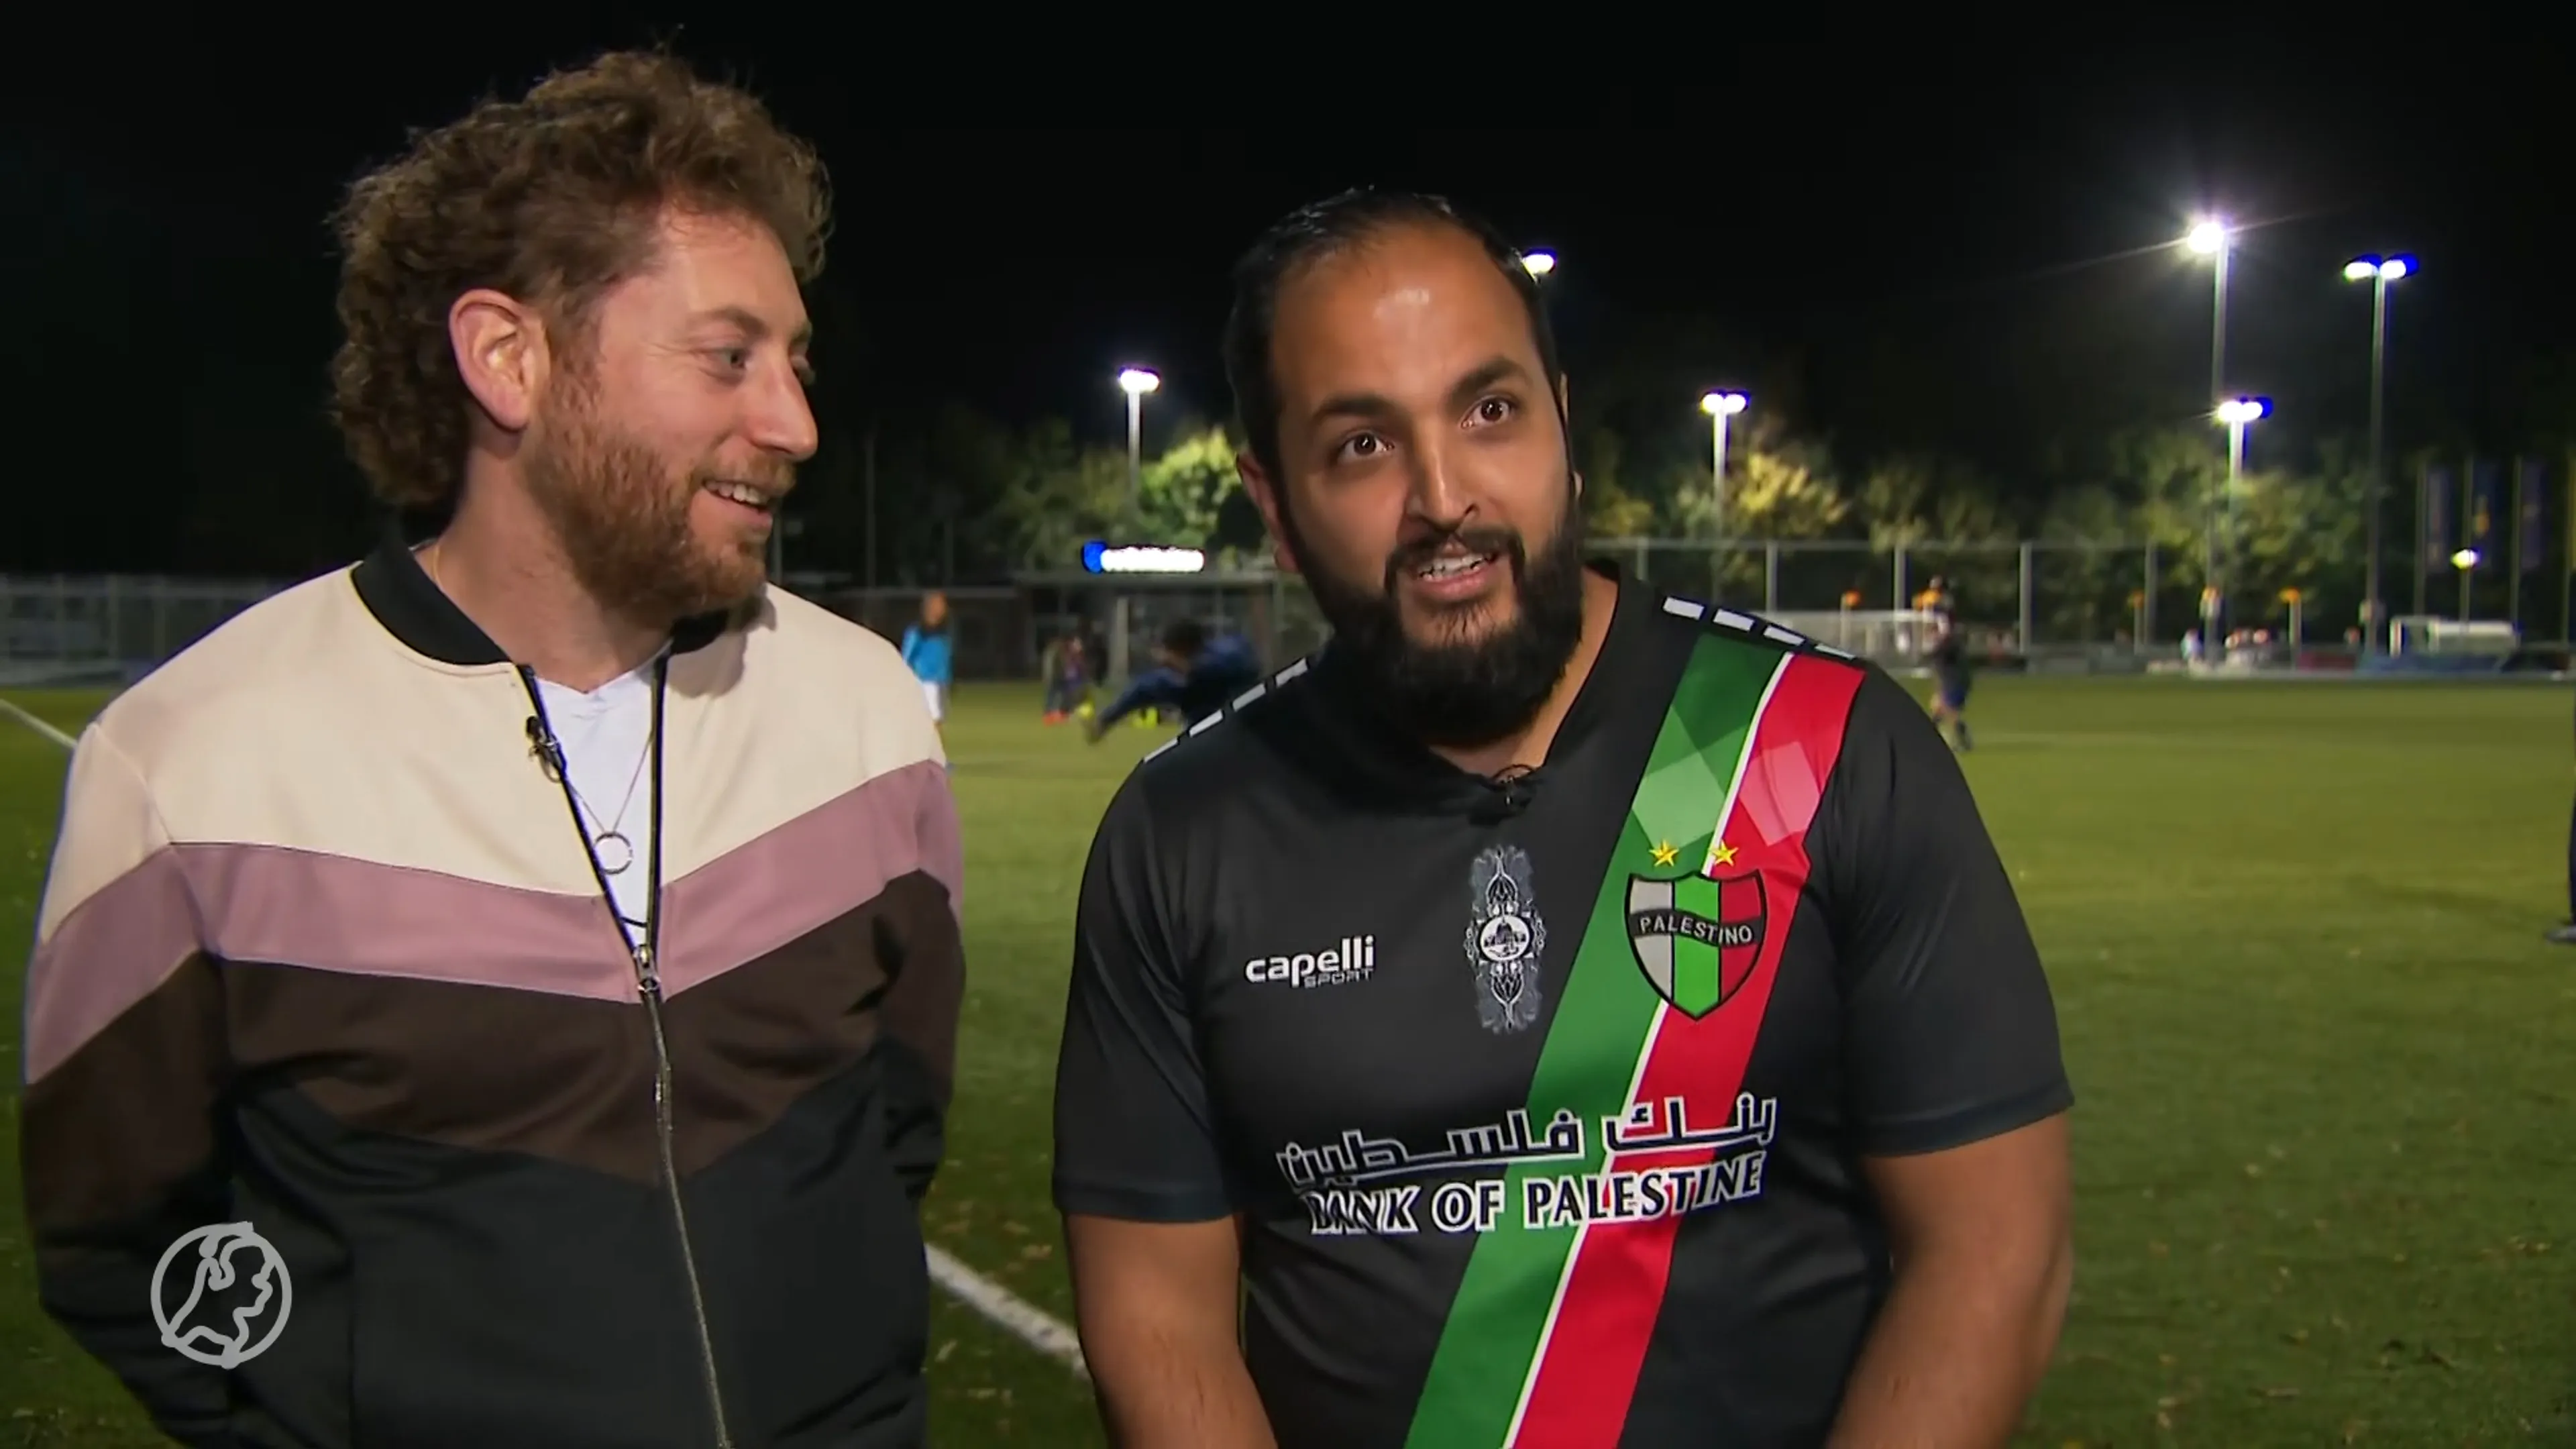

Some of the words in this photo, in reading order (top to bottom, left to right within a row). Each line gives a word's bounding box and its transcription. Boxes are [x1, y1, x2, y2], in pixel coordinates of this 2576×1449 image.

[1639, 912, 1754, 945] PALESTINO
[1245, 934, 1374, 989] capelli
[1303, 967, 1374, 989] SPORT
[1275, 1108, 1585, 1195] فلسطين
[1601, 1091, 1778, 1157] بنك
[1300, 1185, 1421, 1235] BANK
[1431, 1179, 1505, 1233] OF
[1522, 1150, 1768, 1230] PALESTINE
